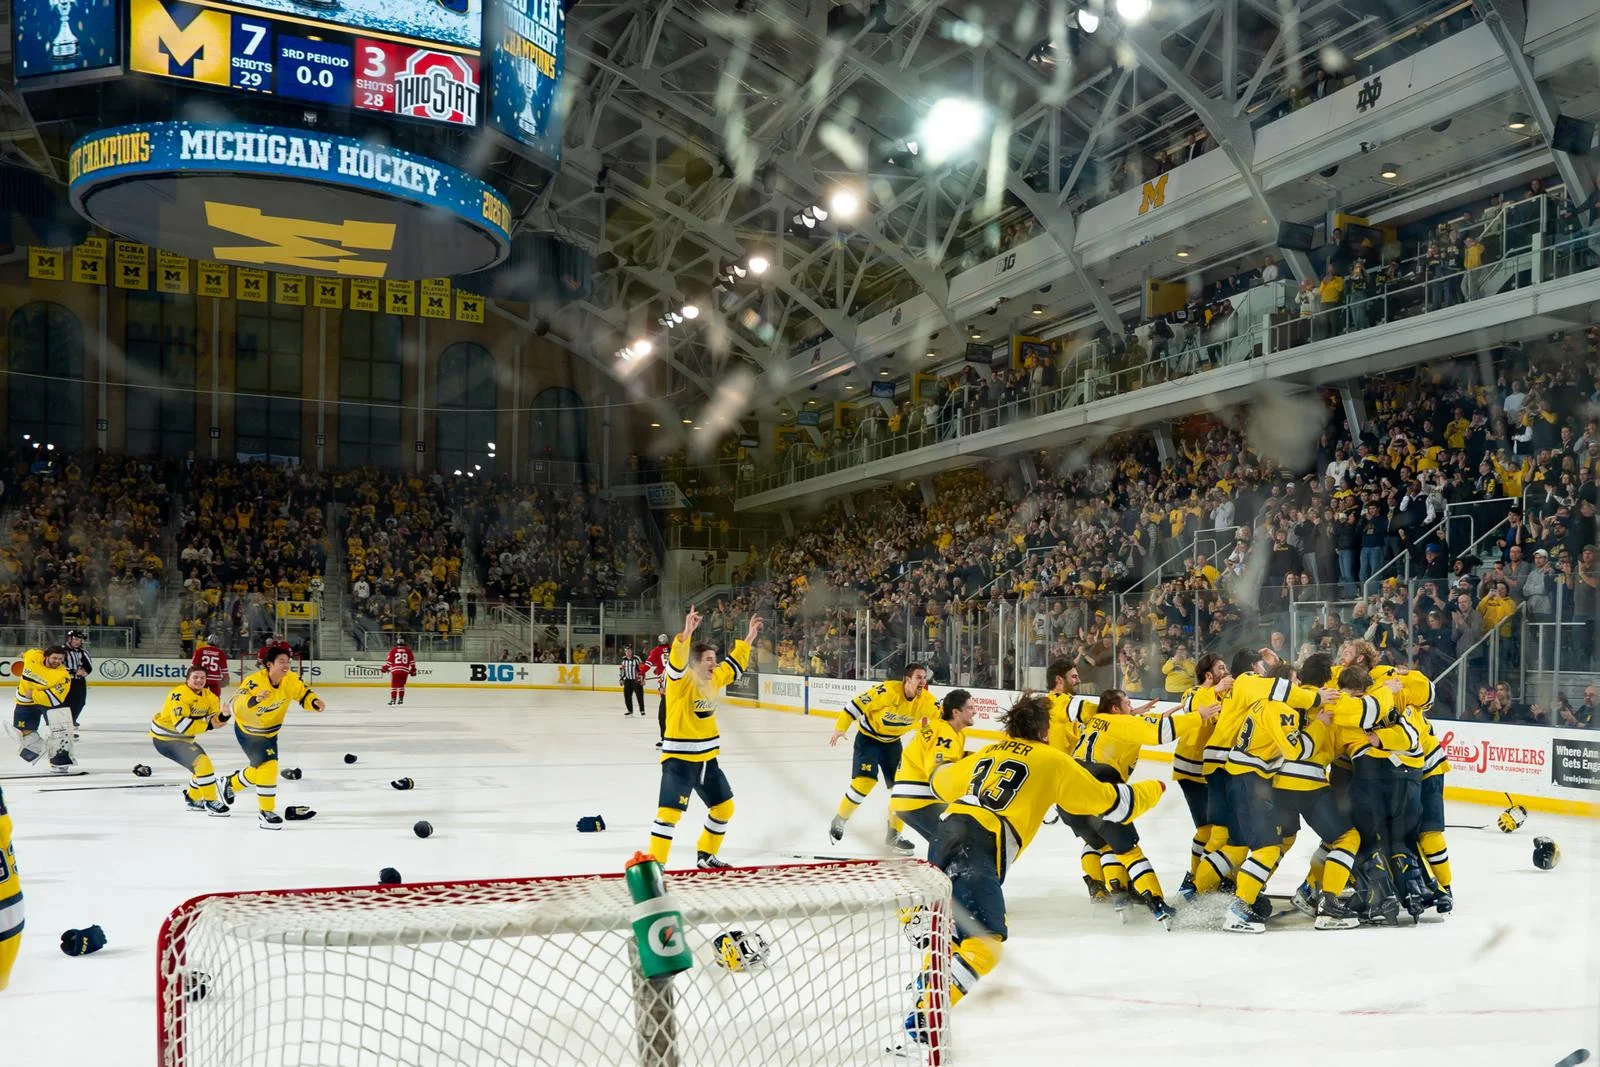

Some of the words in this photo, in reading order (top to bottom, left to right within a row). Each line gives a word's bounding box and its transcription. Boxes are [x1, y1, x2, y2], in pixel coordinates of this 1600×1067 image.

[241, 23, 267, 56] 7
[281, 48, 305, 60] 3RD
[306, 52, 349, 68] PERIOD
[503, 29, 556, 80] CHAMPIONS
[231, 57, 273, 73] SHOTS
[363, 46, 386, 77] 3
[240, 71, 262, 86] 29
[296, 65, 334, 88] 0.0
[355, 78, 394, 93] SHOTS
[363, 92, 384, 107] 28
[82, 131, 150, 173] CHAMPIONS
[180, 130, 331, 172] MICHIGAN
[337, 144, 441, 197] HOCKEY
[1138, 173, 1169, 216] M
[37, 255, 55, 267] M
[81, 260, 98, 272] M
[123, 265, 141, 277] M
[164, 270, 181, 281] M
[205, 274, 221, 286] M
[244, 278, 260, 290] M
[283, 282, 299, 294] M
[320, 285, 336, 297] M
[357, 289, 373, 300] M
[392, 294, 408, 305] M
[427, 296, 443, 308] M
[425, 308, 446, 316] 2022
[463, 301, 478, 312] M
[289, 602, 305, 613] M
[201, 655, 220, 672] 25
[394, 653, 408, 664] 28
[132, 663, 188, 678] Allstat
[347, 666, 380, 677] Hilton
[557, 665, 580, 684] M
[171, 693, 181, 701] M
[1280, 714, 1295, 726] M
[936, 736, 953, 749] M
[1477, 740, 1545, 774] JEWELERS
[1556, 745, 1582, 758] Where
[1582, 747, 1600, 759] Ann
[1562, 760, 1582, 769] Gets
[1582, 761, 1600, 773] Enga
[1563, 774, 1600, 785] lewisjeweler
[647, 915, 686, 957] G
